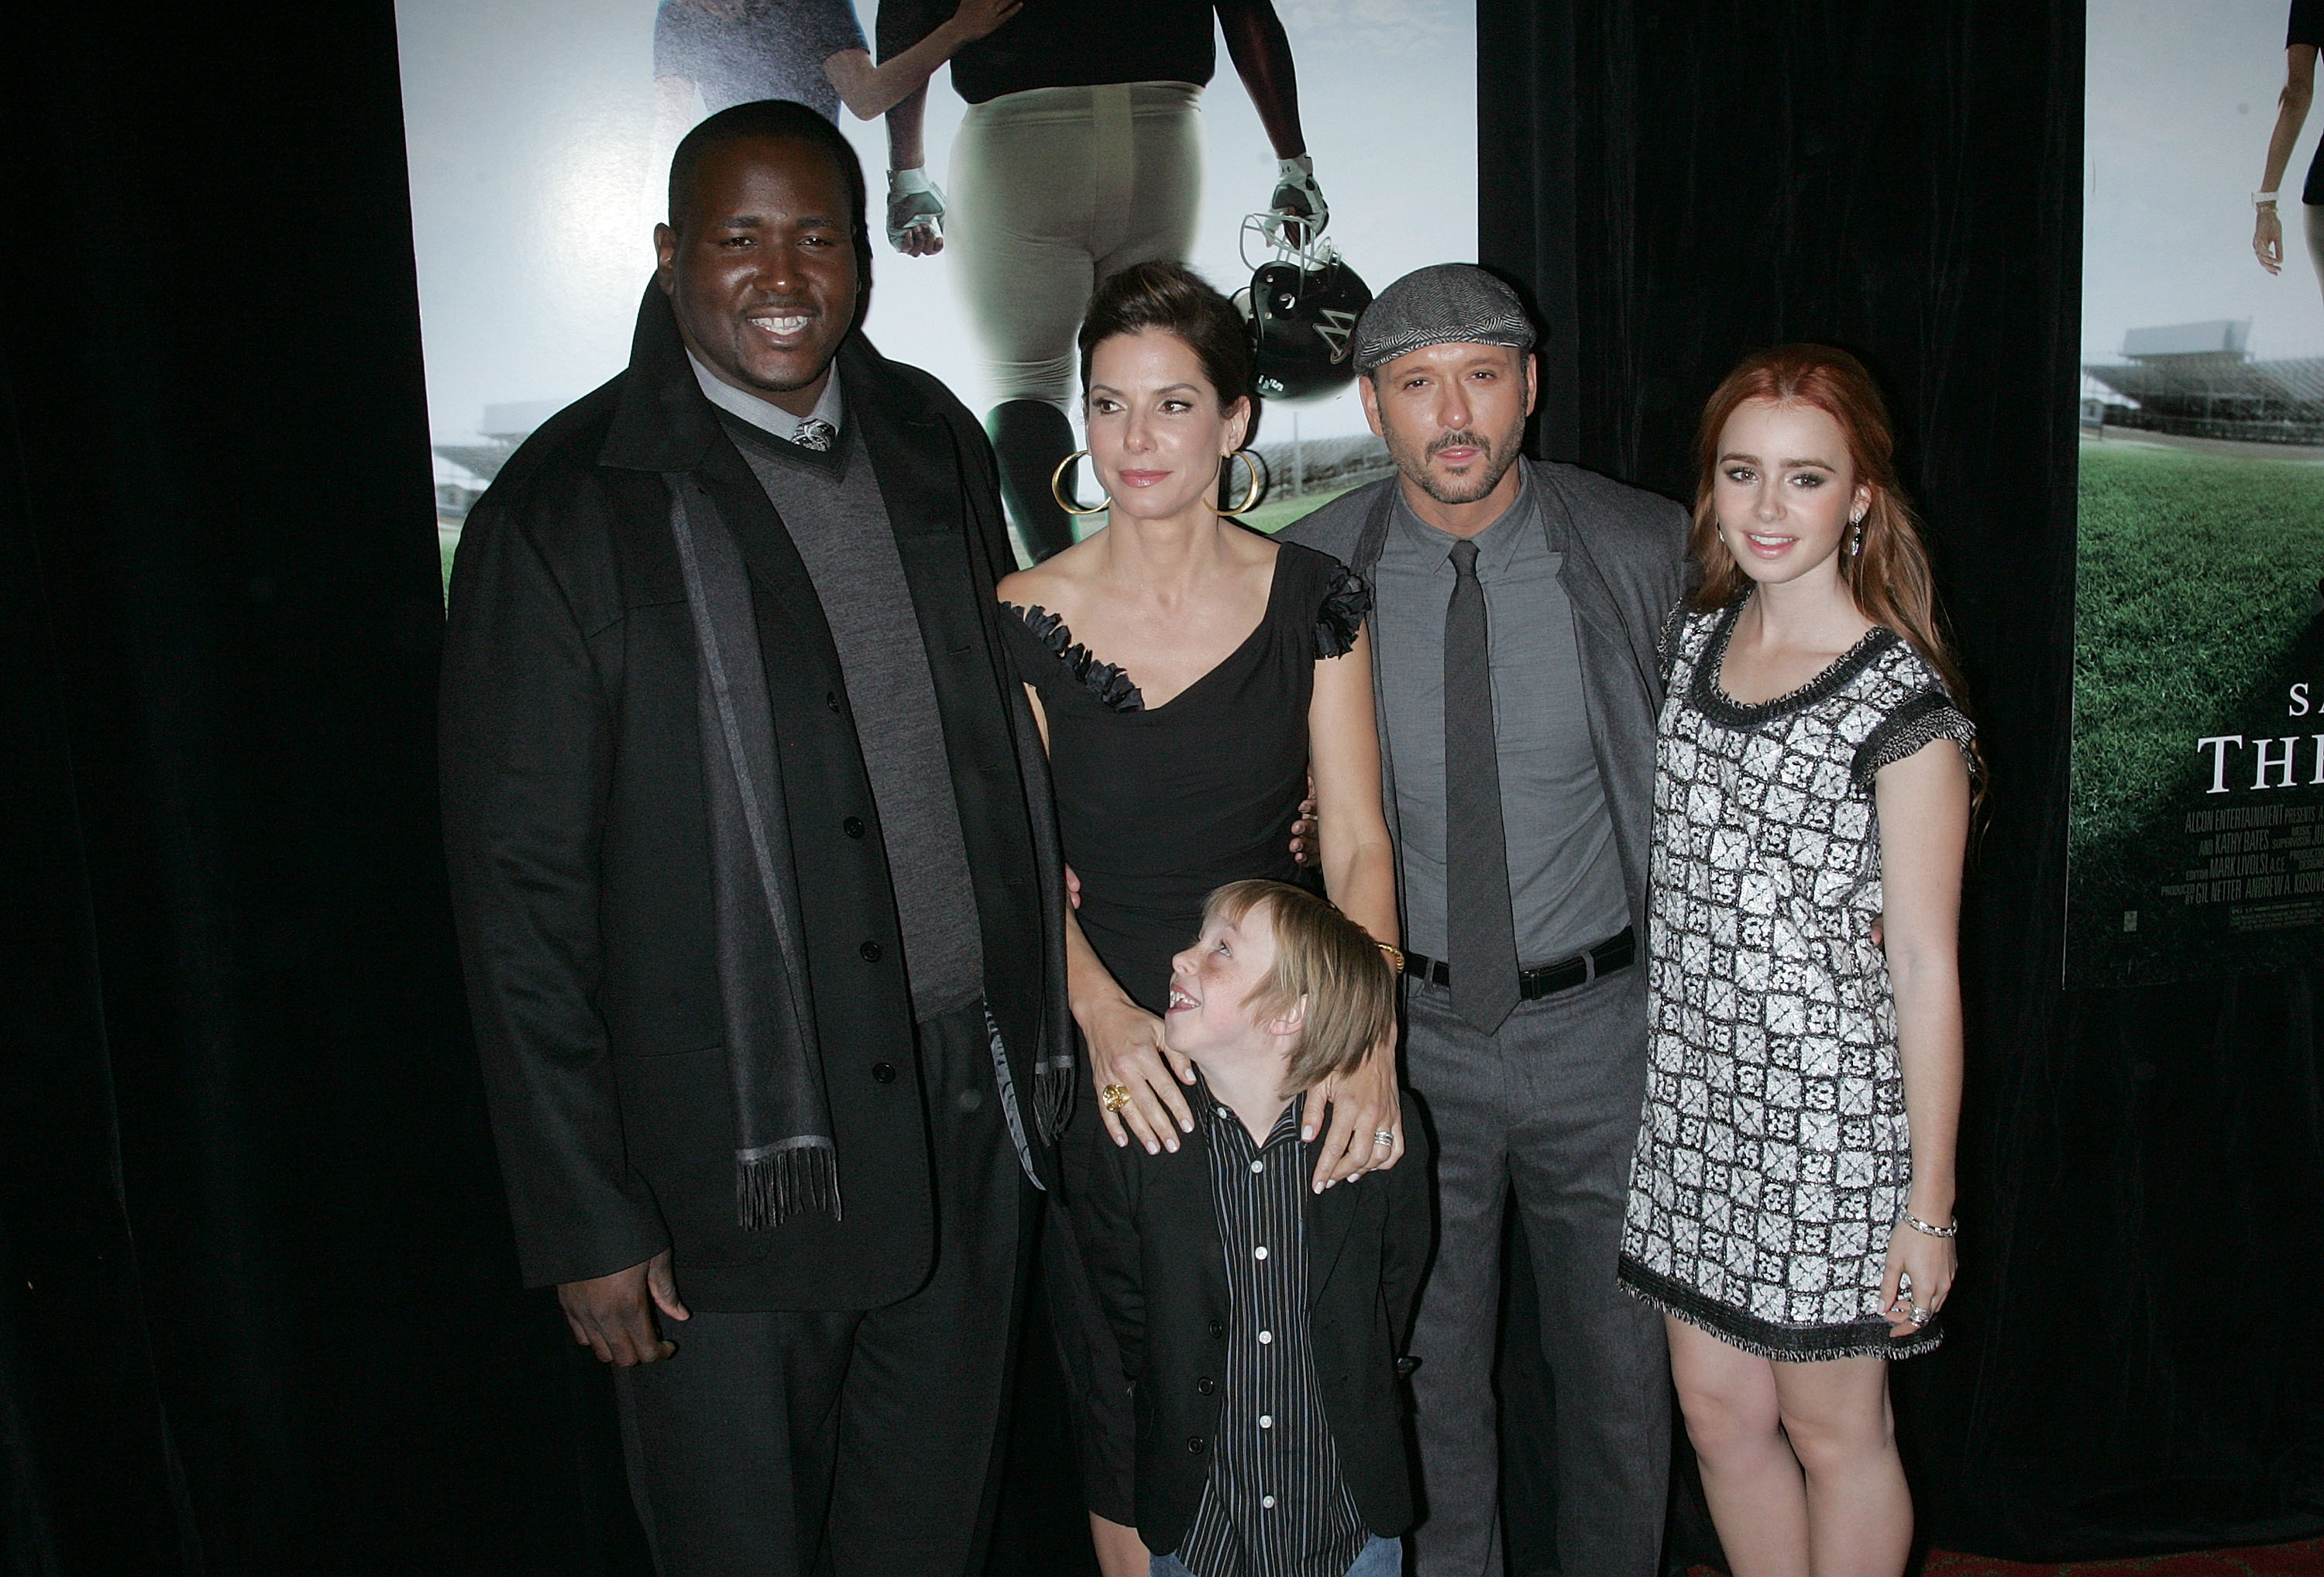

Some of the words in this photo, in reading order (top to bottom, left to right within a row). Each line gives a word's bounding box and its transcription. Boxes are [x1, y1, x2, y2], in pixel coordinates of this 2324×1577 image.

[2288, 682, 2324, 716] S
[2185, 809, 2213, 834] ALCON
[2215, 804, 2284, 831] ENTERTAINMENT
[2284, 806, 2315, 824] PRESENTS
[2215, 831, 2243, 856] KATHY
[2243, 829, 2270, 852] BATES
[2185, 868, 2209, 881] EDITOR
[2209, 856, 2236, 879] MARK
[2195, 881, 2209, 904] GIL
[2211, 879, 2241, 902] NETTER
[2245, 874, 2284, 898] ANDREW
